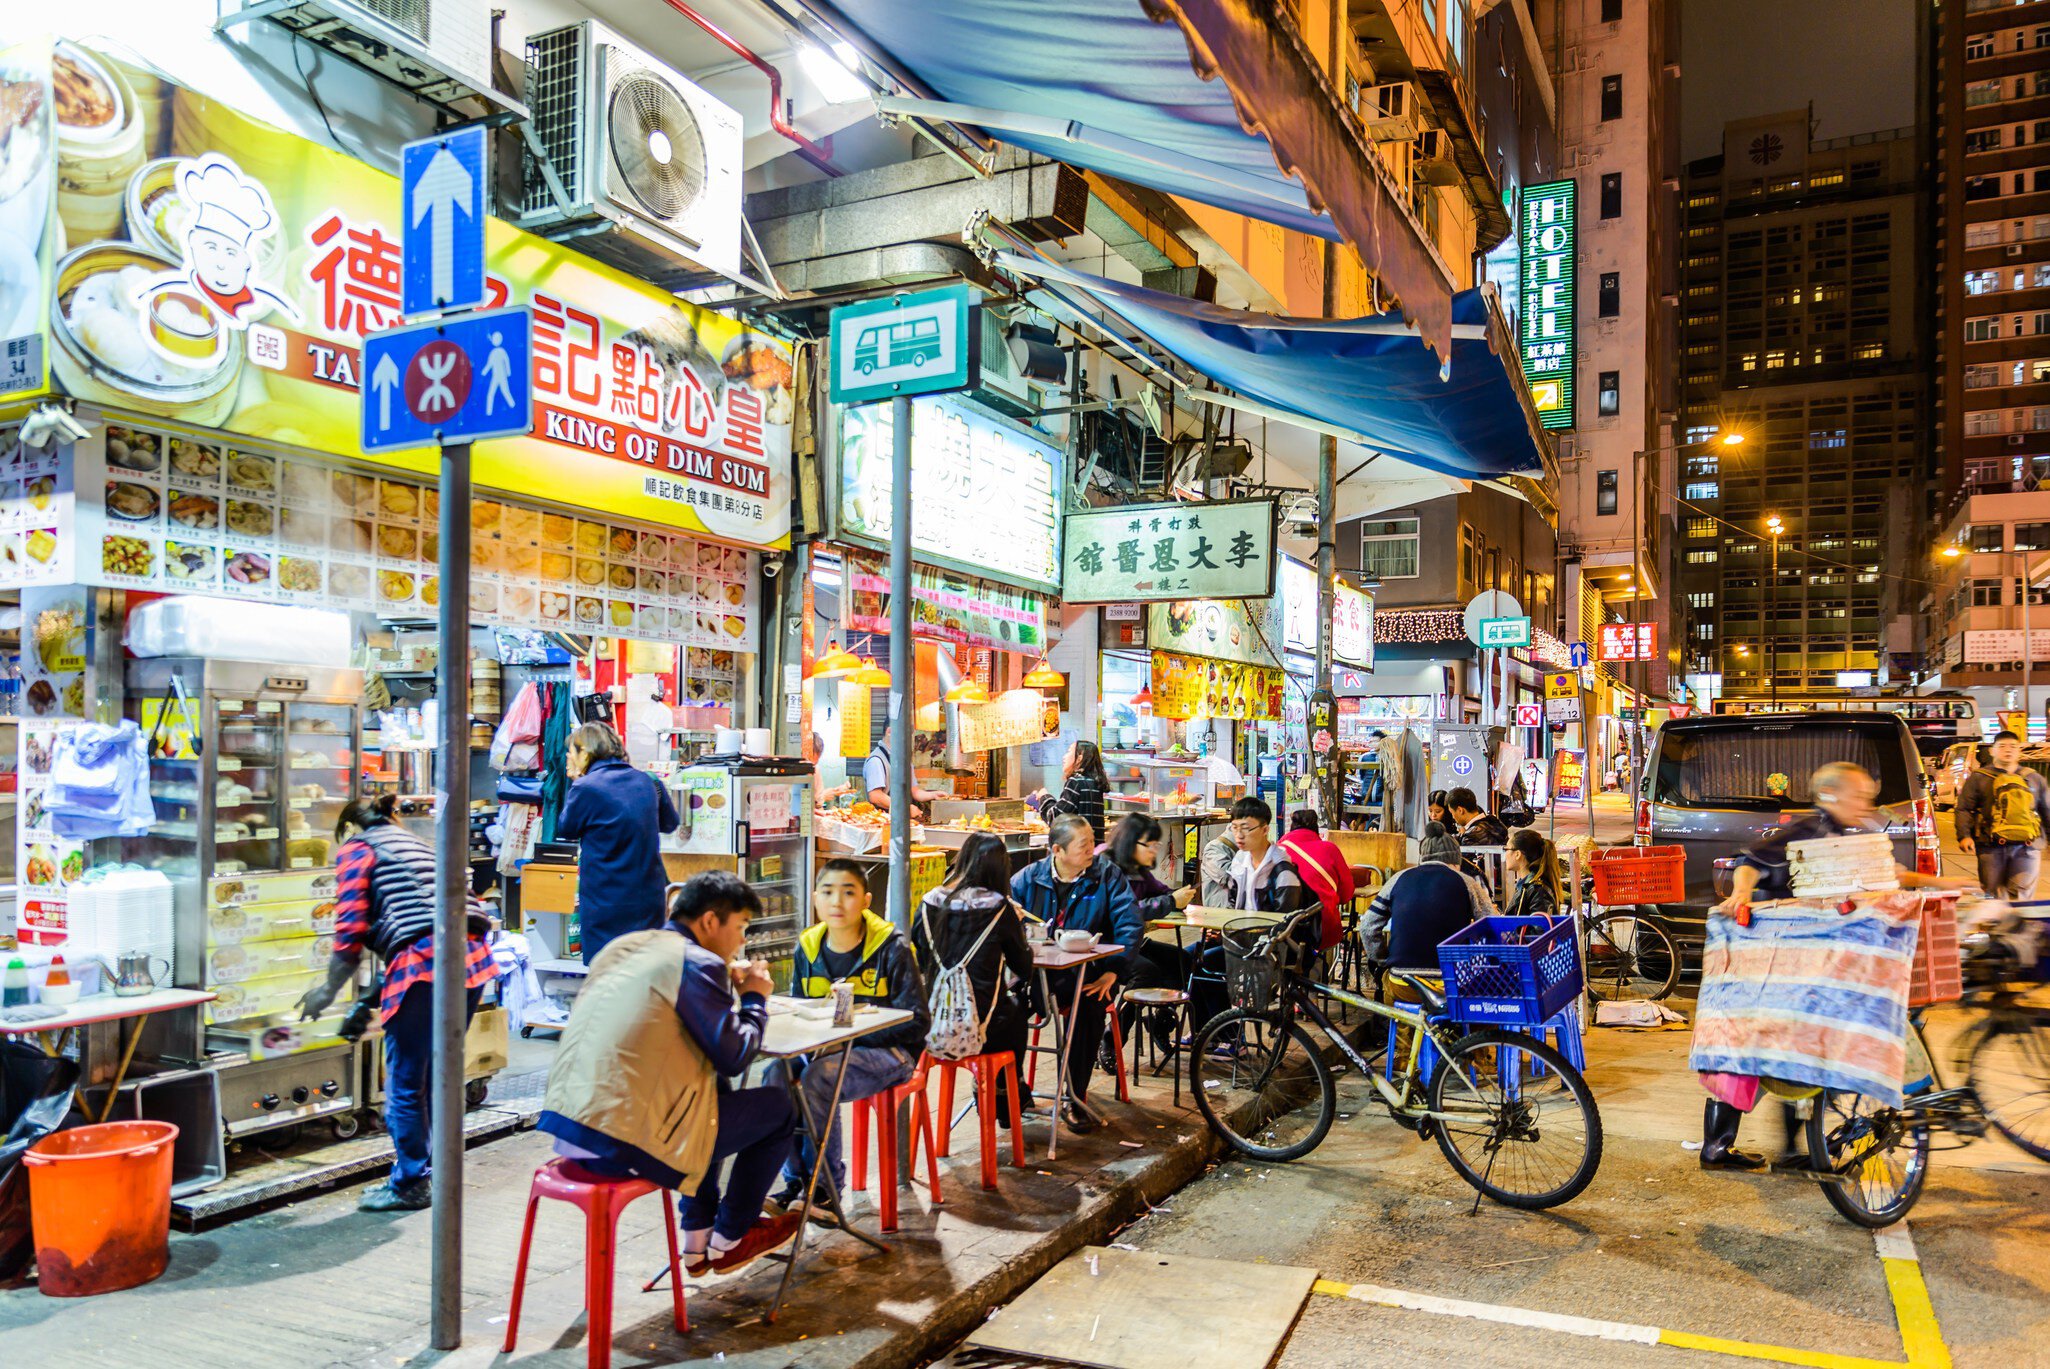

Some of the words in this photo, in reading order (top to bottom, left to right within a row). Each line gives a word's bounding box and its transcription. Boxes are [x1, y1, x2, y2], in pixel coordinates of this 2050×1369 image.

[1528, 260, 1539, 289] TEA
[1541, 196, 1567, 337] HOTEL
[545, 410, 617, 454] KING
[625, 433, 659, 463] OF
[668, 443, 714, 478] DIM
[721, 461, 765, 492] SUM
[1566, 699, 1572, 707] 7
[1567, 710, 1578, 719] 12
